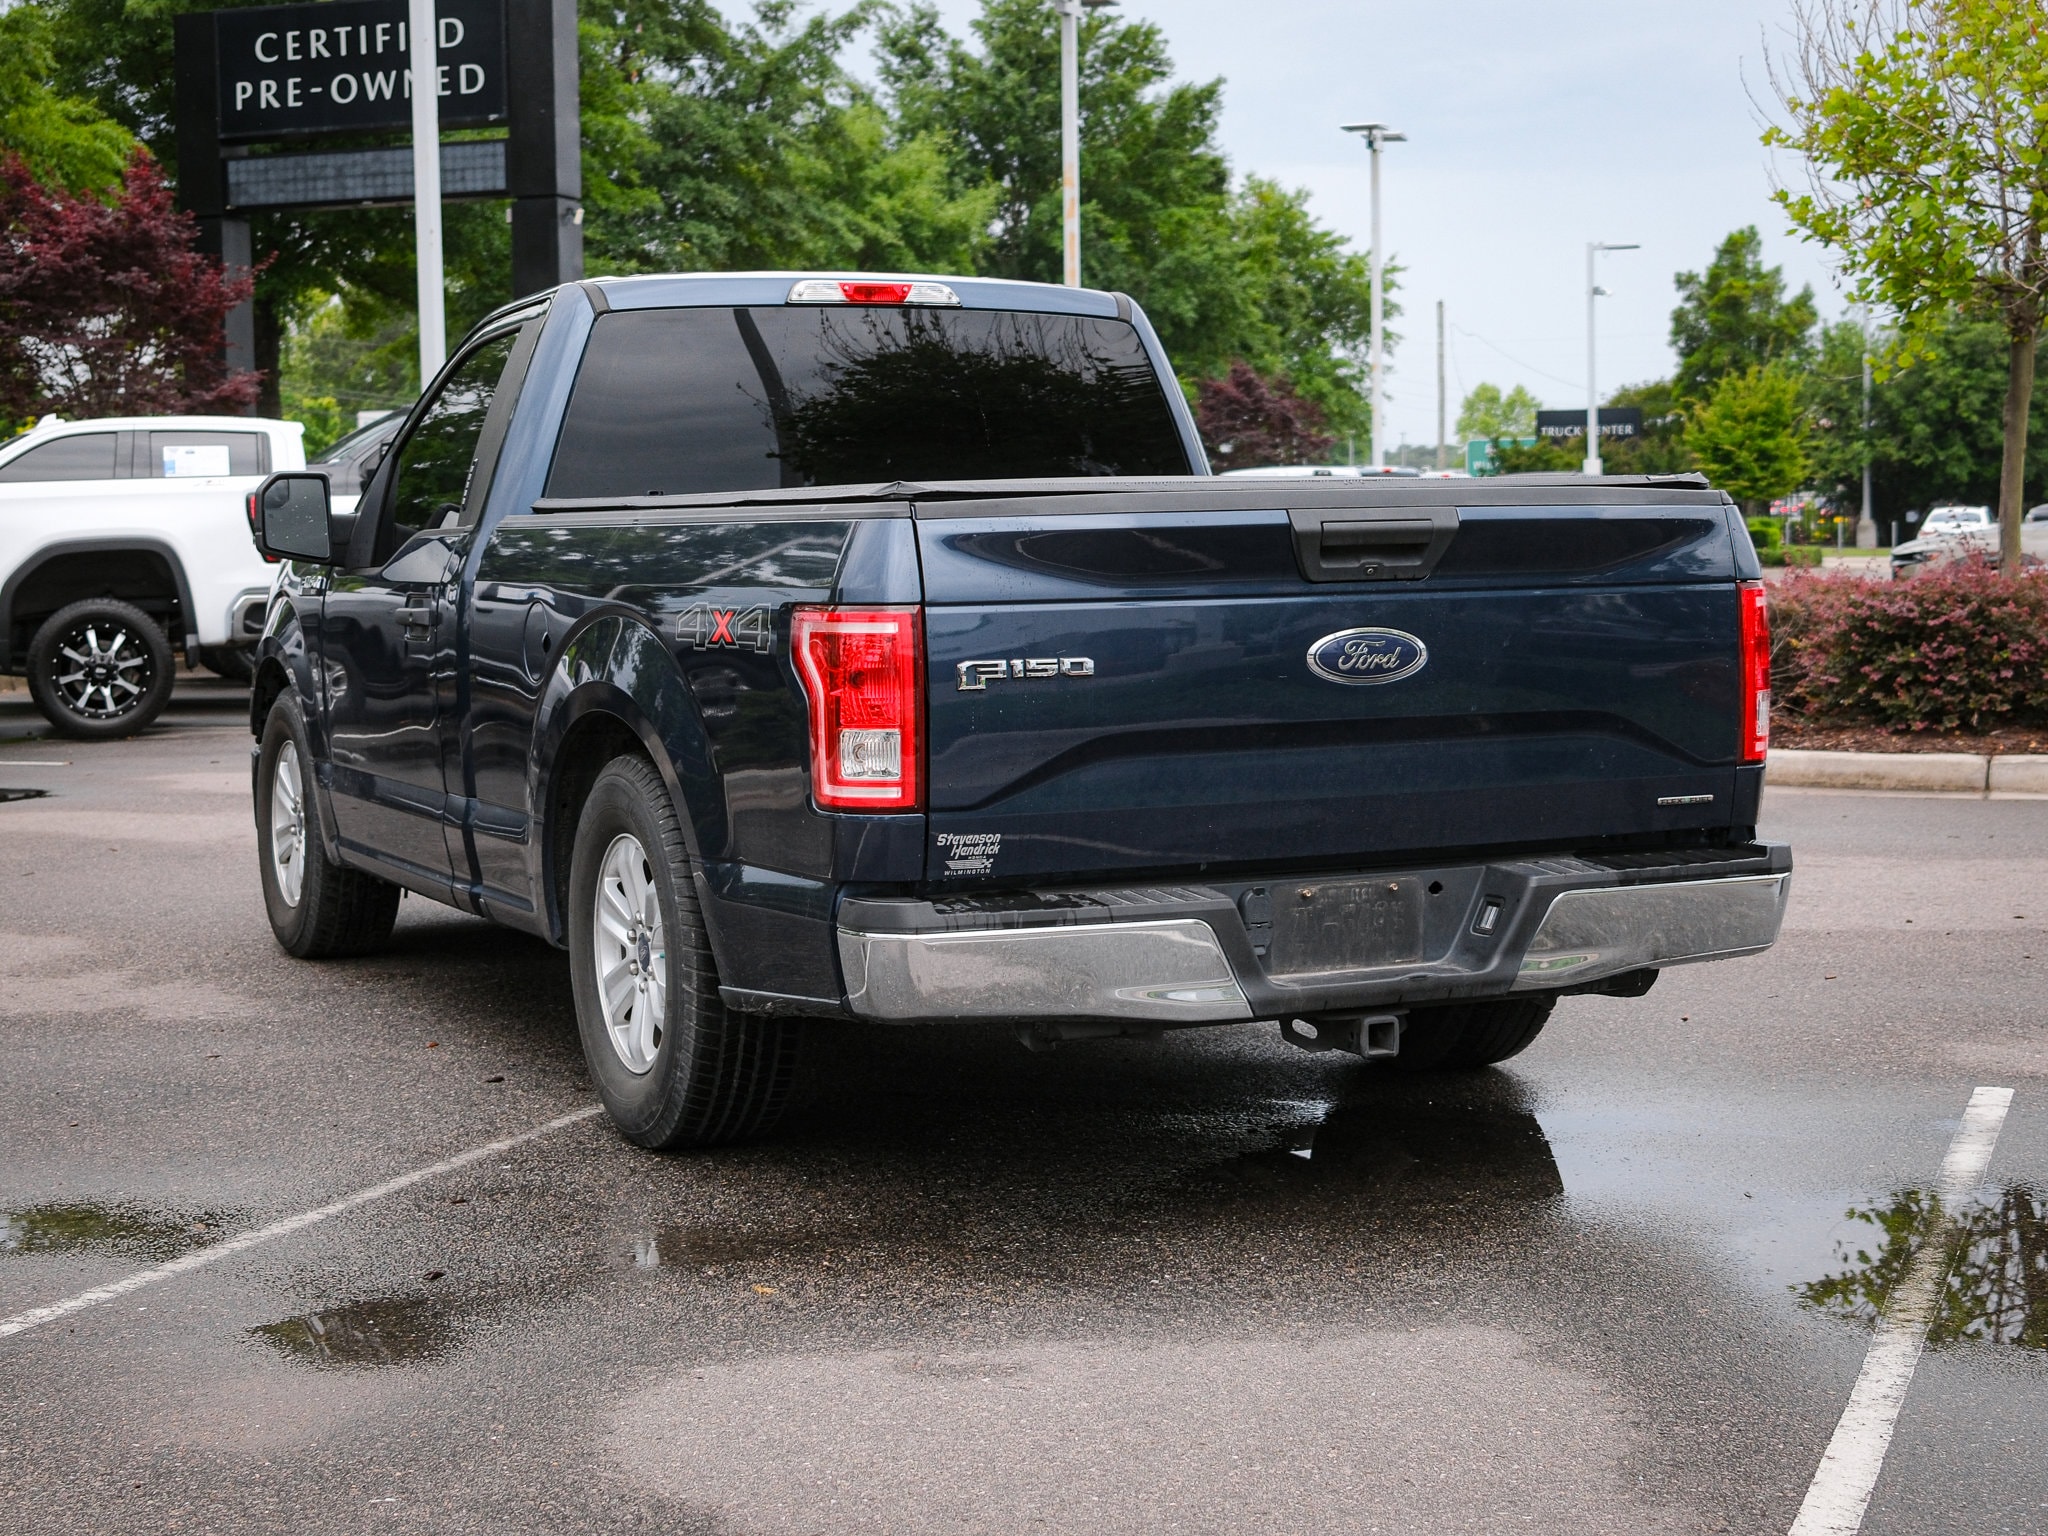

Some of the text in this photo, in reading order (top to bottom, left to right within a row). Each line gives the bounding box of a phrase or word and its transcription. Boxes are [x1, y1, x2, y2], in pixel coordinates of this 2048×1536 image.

[254, 17, 465, 63] CERTIFID
[1540, 424, 1634, 437] TRUCK ENTER
[1338, 639, 1401, 670] Ford
[937, 833, 1001, 846] Stevenson
[950, 843, 1001, 860] Hendrick
[944, 868, 991, 876] WILMINGTON
